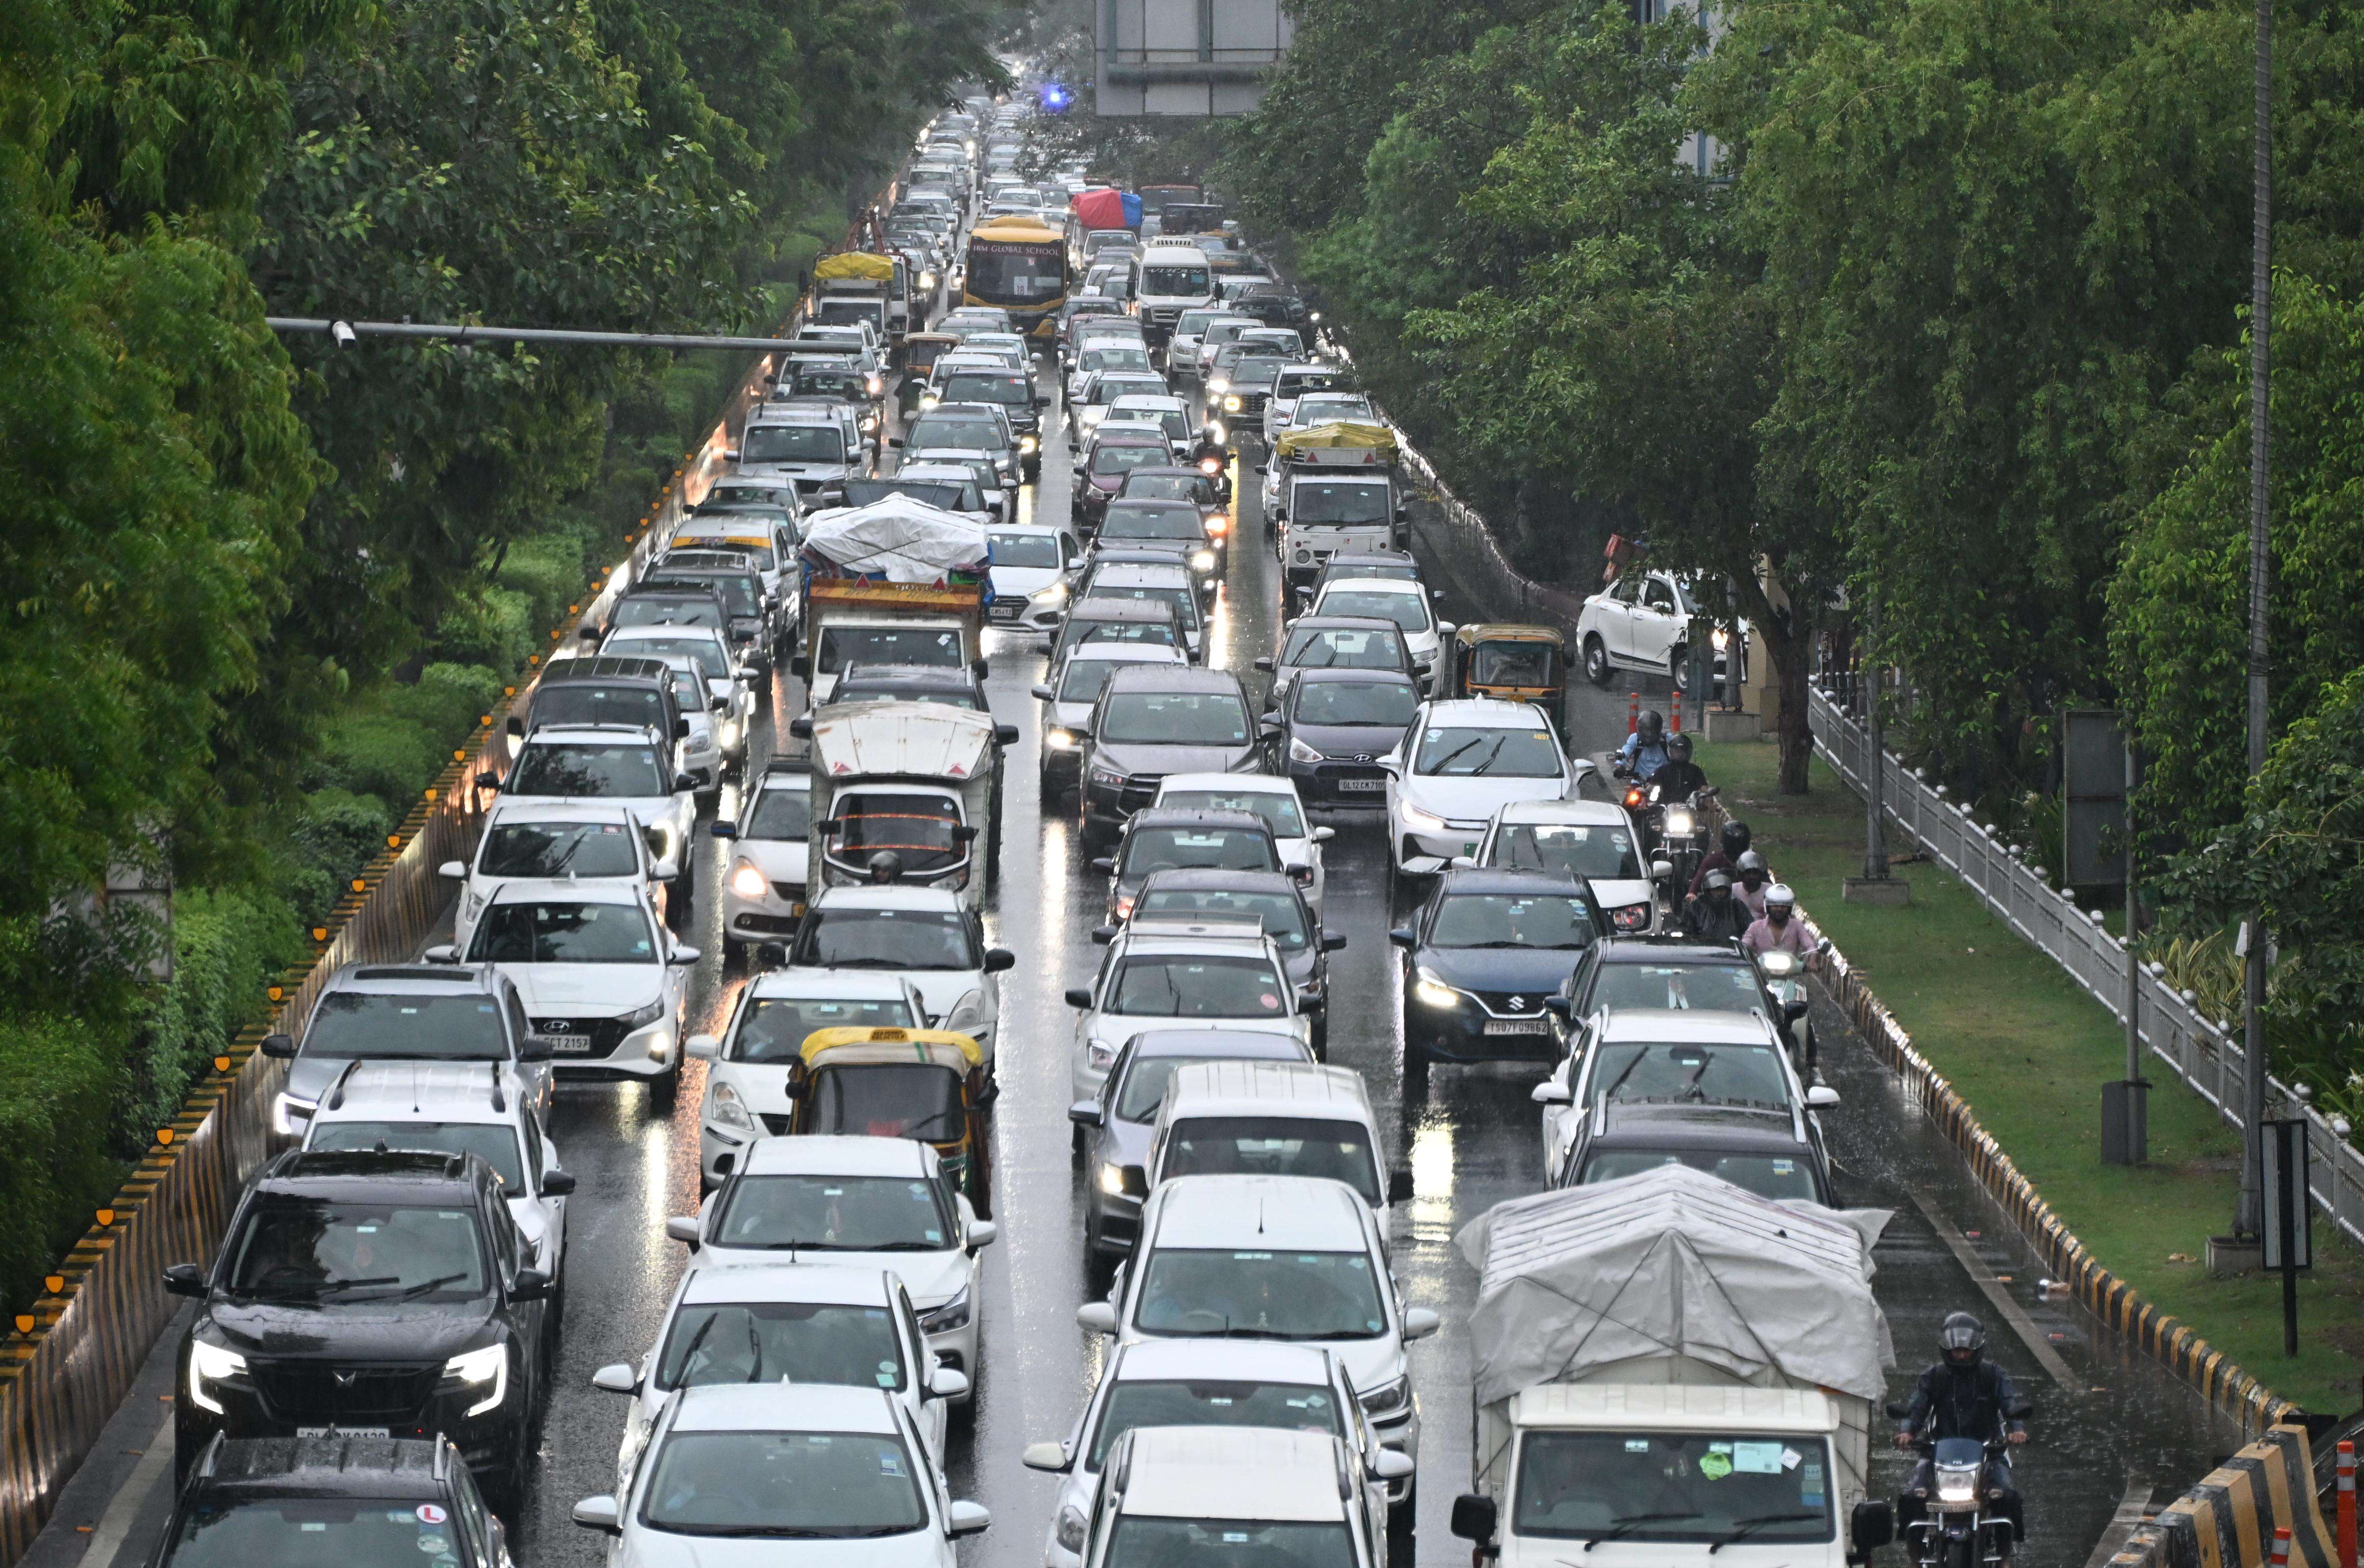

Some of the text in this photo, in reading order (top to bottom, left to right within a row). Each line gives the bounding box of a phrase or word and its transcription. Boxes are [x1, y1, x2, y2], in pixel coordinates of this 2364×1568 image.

[991, 245, 1023, 253] GLOBAL
[1026, 246, 1059, 256] SCHOOL
[424, 1507, 440, 1522] L
